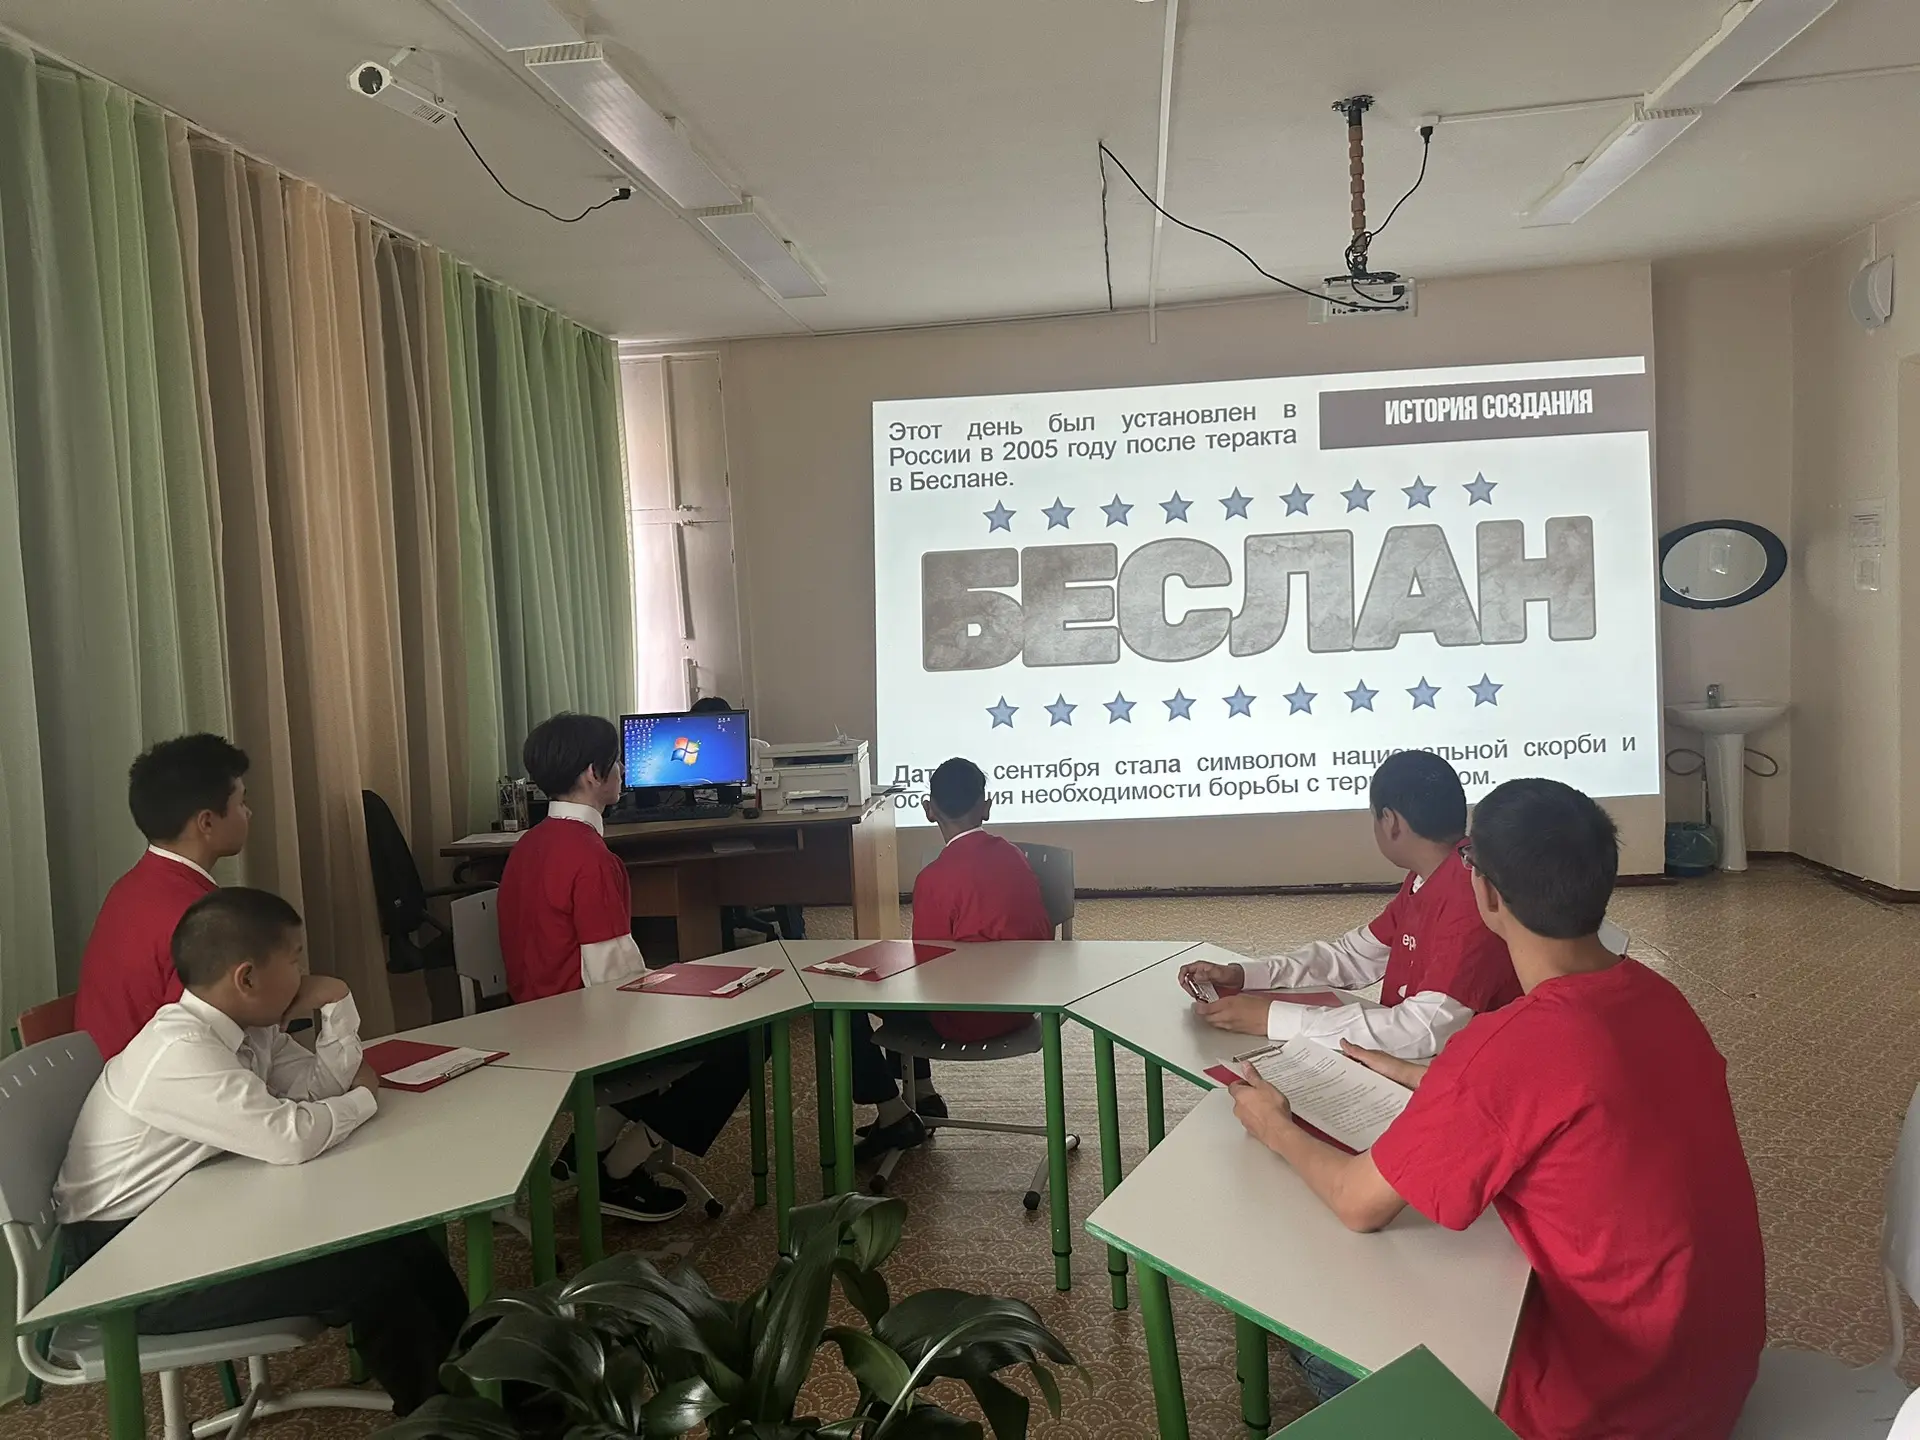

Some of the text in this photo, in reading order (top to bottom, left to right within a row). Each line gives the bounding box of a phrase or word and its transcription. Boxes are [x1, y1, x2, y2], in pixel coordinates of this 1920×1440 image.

[888, 403, 1297, 442] Этот день был установлен в
[1385, 388, 1593, 425] ИСТОРИЯ СОЗДАНИЯ
[889, 427, 1297, 466] России в 2005 году после теракта
[889, 470, 1015, 492] в Беслане.
[921, 516, 1597, 673] БЕСЛАН
[892, 764, 937, 788] Дат
[993, 757, 1101, 780] сентября
[1114, 755, 1182, 775] стала
[1197, 751, 1317, 772] символом
[1523, 734, 1607, 760] скорби
[1621, 734, 1636, 752] и
[1020, 780, 1201, 804] необходимости
[1209, 774, 1299, 798] борьбы
[1306, 777, 1320, 792] с
